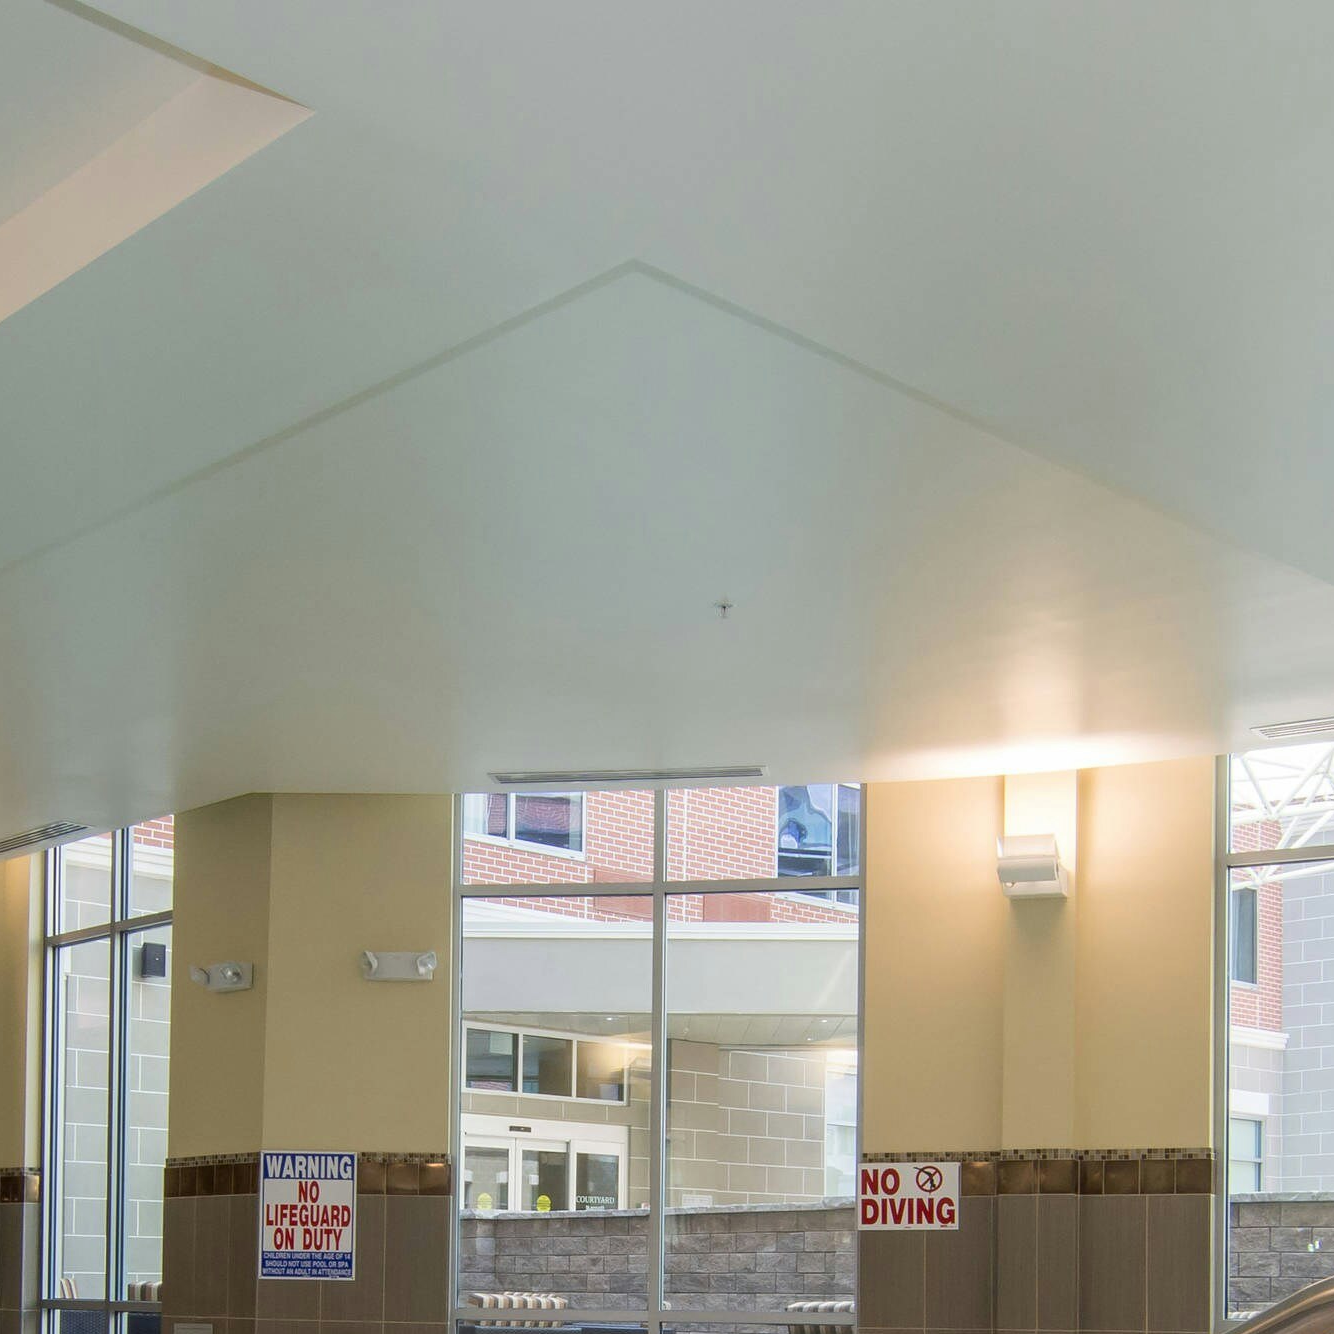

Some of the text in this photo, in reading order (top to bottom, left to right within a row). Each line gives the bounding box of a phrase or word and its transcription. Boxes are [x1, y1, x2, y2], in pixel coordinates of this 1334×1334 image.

[266, 1155, 353, 1179] WARNING
[298, 1181, 320, 1203] NO
[861, 1168, 900, 1195] NO
[576, 1195, 615, 1204] COURTYARD
[861, 1197, 955, 1225] DIVING
[266, 1204, 351, 1227] LIFEGUARD
[273, 1227, 343, 1251] ON DUTY
